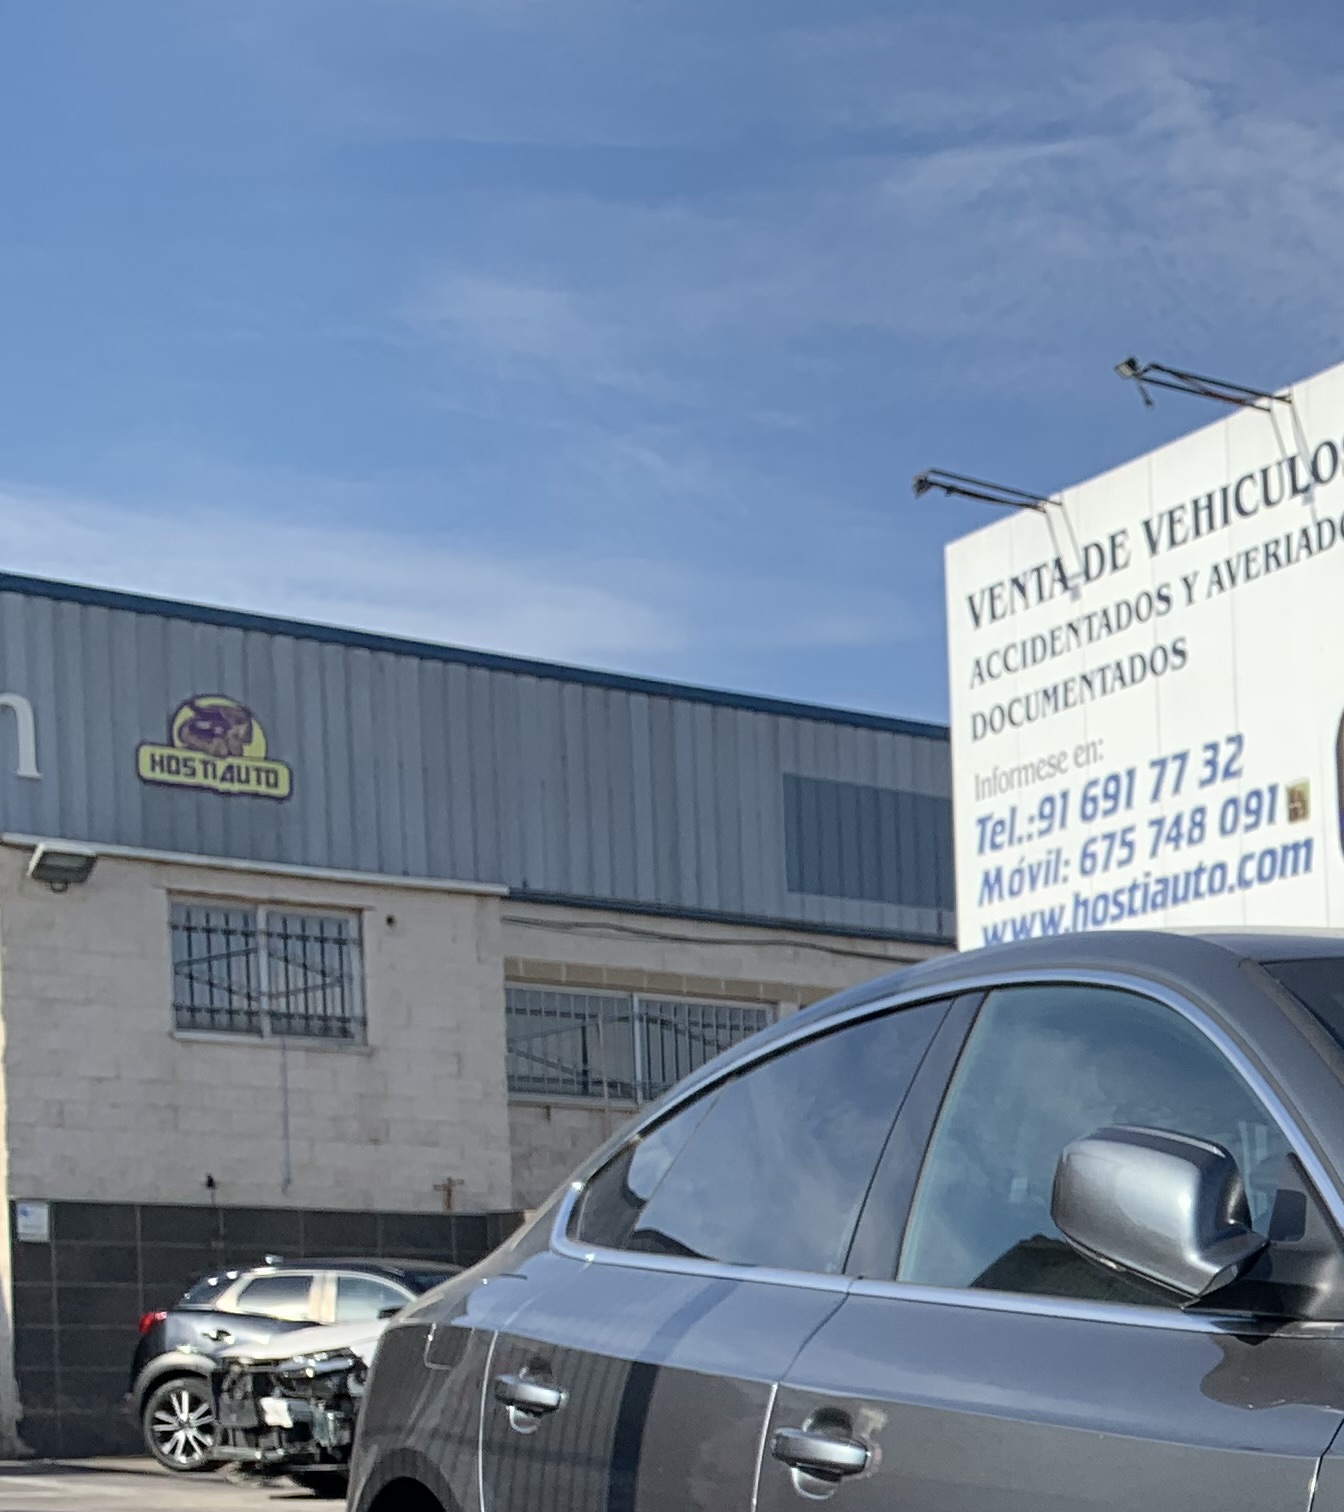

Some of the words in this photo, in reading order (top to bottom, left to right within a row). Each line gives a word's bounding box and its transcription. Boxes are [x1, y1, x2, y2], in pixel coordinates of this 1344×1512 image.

[966, 556, 1069, 631] VENTA
[1083, 527, 1132, 584] DE
[969, 584, 1173, 690] ACCIDENTADOS
[1179, 573, 1199, 607] Y
[970, 636, 1188, 742] DOCUMENTADOS
[150, 752, 279, 789] HOSTIAUTO
[973, 750, 1071, 803] Informese
[1073, 736, 1105, 769] en:
[1080, 766, 1137, 822] 691
[1148, 750, 1189, 804] 77
[1197, 733, 1246, 790] 32
[976, 845, 1070, 908] Móvil:
[1079, 824, 1136, 879] 675
[1149, 806, 1208, 858] 748
[1218, 782, 1280, 840] 091
[979, 836, 1315, 948] www.hostiauto.com
